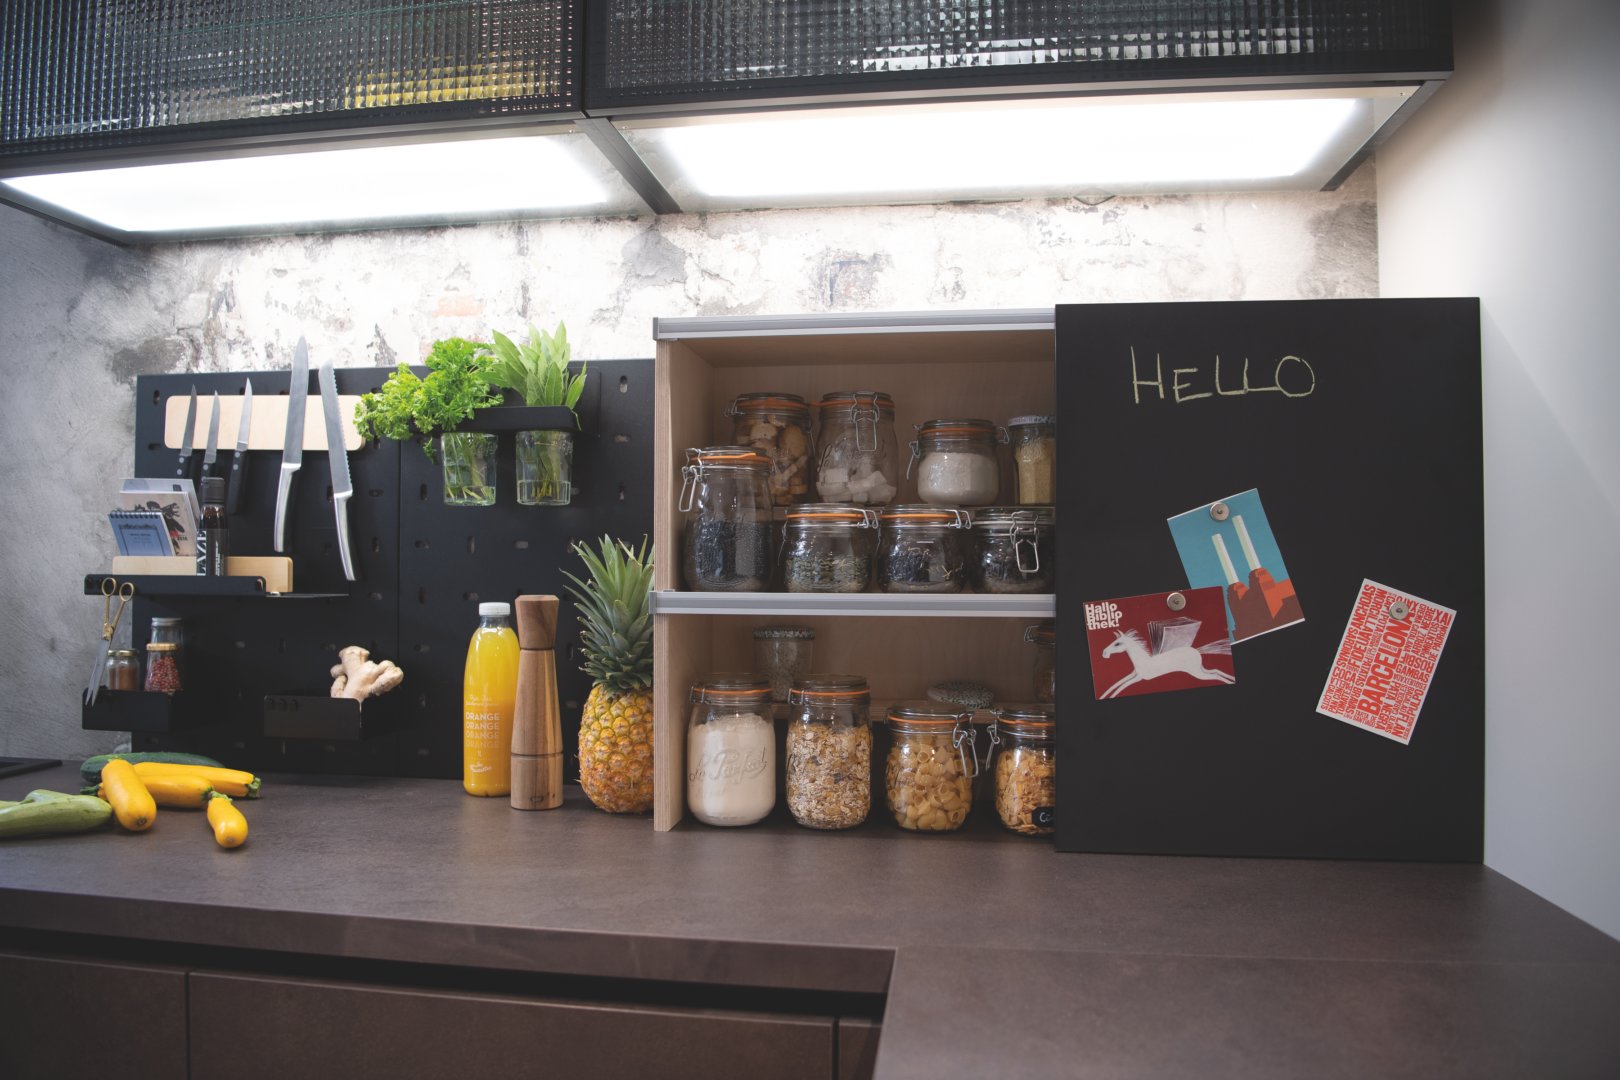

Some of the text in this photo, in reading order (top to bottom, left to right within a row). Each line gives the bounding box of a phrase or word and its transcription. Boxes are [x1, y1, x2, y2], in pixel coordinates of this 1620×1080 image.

[1130, 345, 1315, 404] HELLO
[1085, 602, 1117, 614] Hallo
[1350, 583, 1376, 629] ANCHOAS
[1361, 587, 1387, 633] MORCILLA
[1433, 609, 1452, 625] XAI
[1403, 603, 1427, 652] CREMA CATALANA
[1410, 605, 1435, 655] ARROZ NEGRE
[1335, 626, 1358, 667] SARDINAS
[1427, 651, 1438, 661] DE
[1331, 665, 1357, 683] COCA
[1354, 656, 1373, 687] PATATAS
[1394, 663, 1430, 683] GAMBAS
[1398, 651, 1434, 673] ROSBIF
[1335, 689, 1350, 715] TOMATE
[1344, 686, 1362, 714] BRAVAS
[1374, 679, 1401, 730] PATA NEGRA
[1406, 688, 1424, 716] PULPO
[466, 712, 500, 721] ORANGE
[466, 721, 500, 731] ORANGE
[1391, 712, 1409, 737] FLAN
[466, 731, 500, 740] ORANGE
